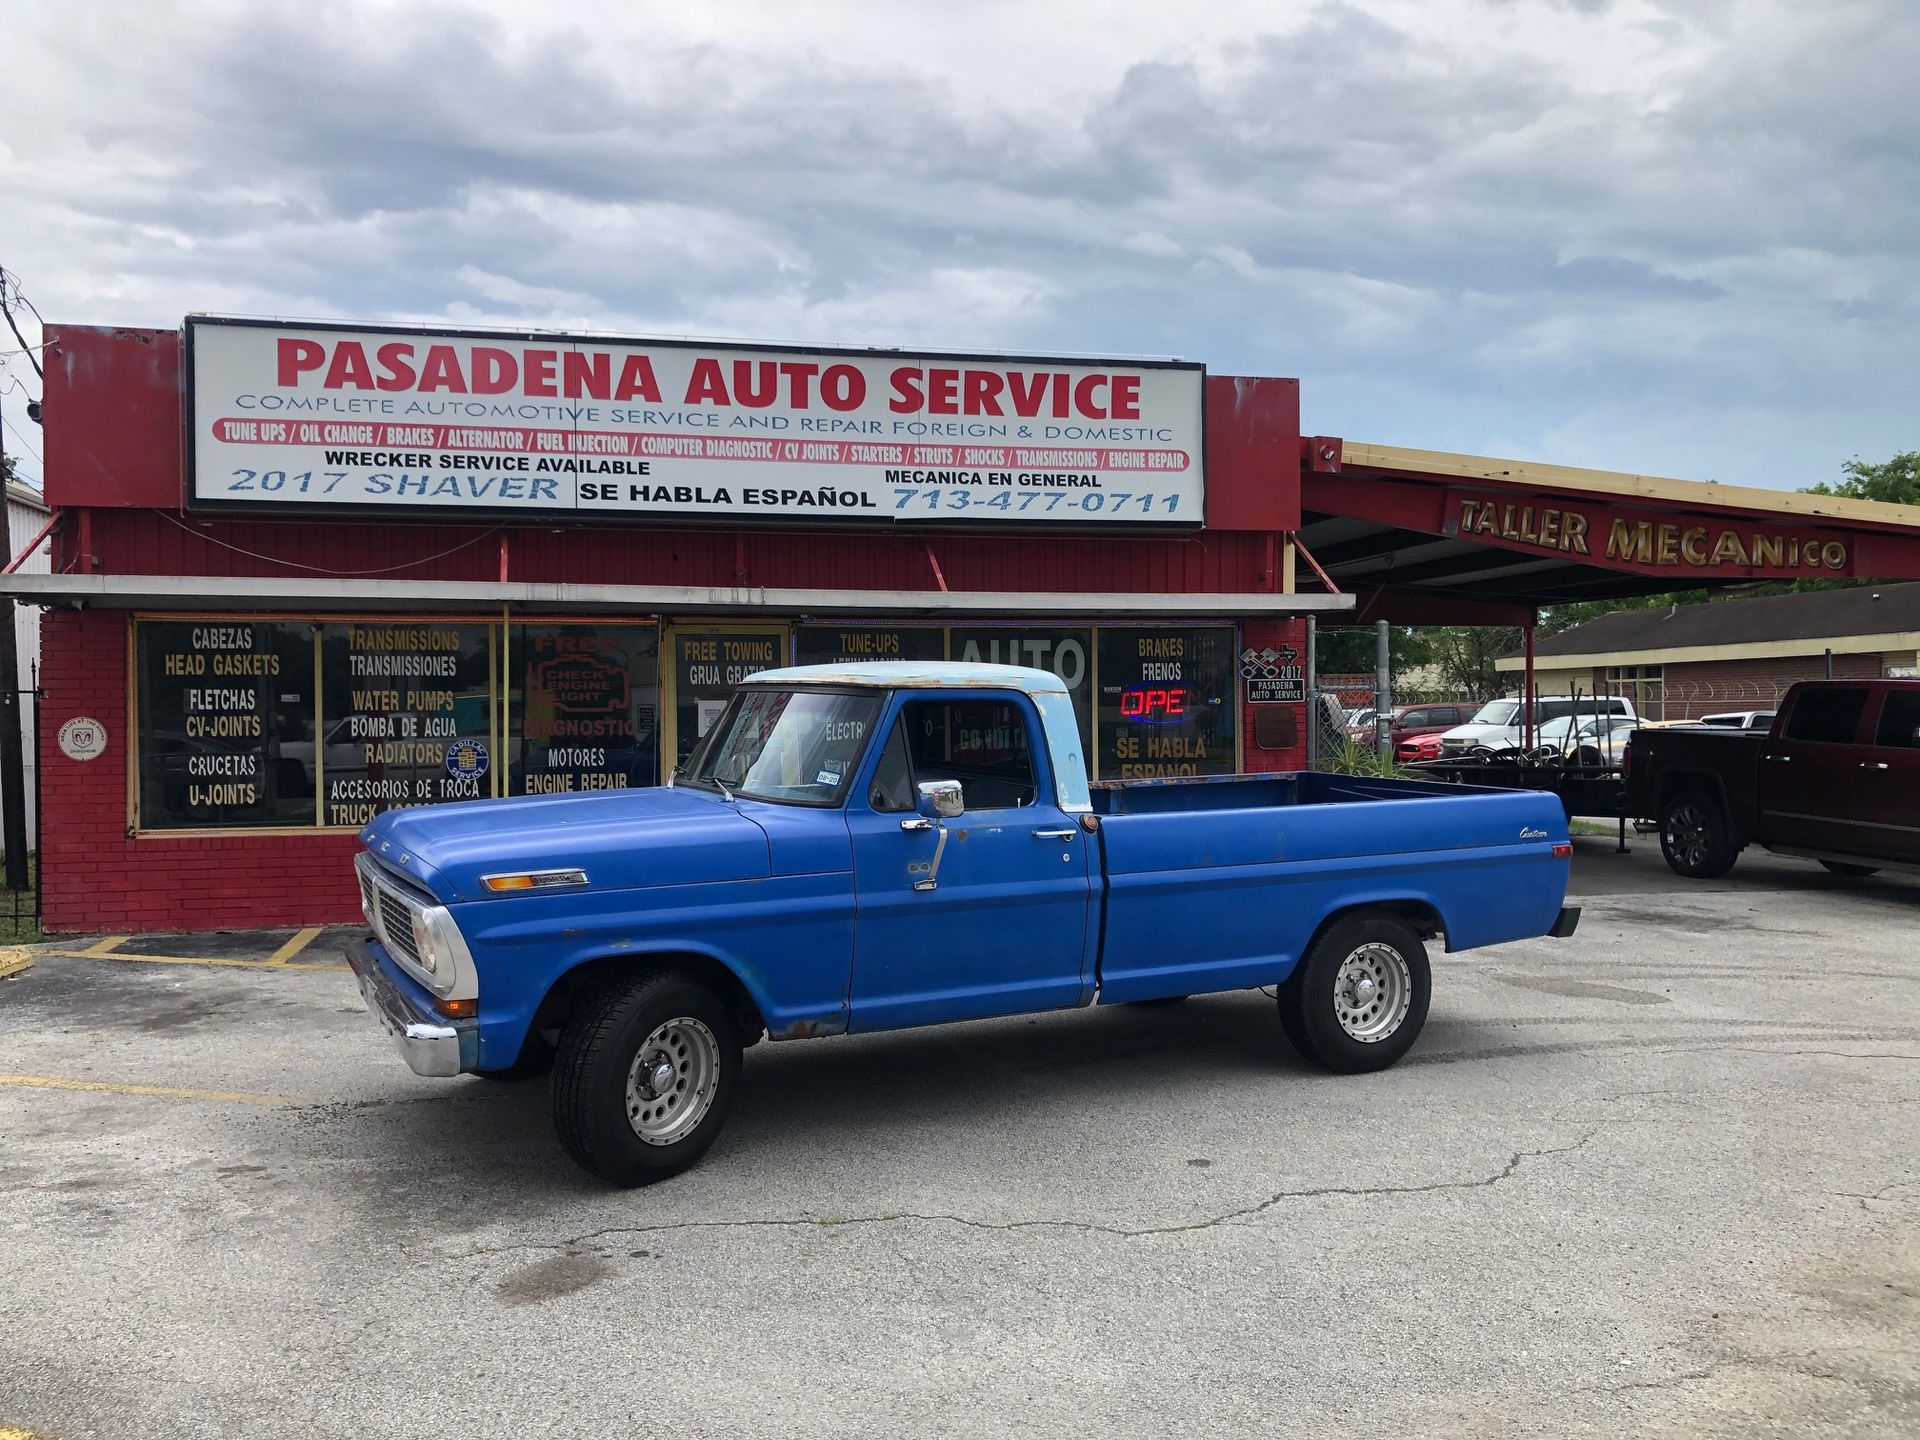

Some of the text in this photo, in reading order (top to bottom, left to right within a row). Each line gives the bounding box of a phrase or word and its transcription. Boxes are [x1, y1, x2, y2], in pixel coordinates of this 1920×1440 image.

[276, 338, 1140, 420] PASADENA AUTO SERVICE
[235, 394, 1173, 442] COMPLETE AUTOMOTIVE SERVICE AND REPAIR FOREIGN & DOMESTIC
[223, 421, 257, 441] TUNE
[260, 422, 286, 442] UPS
[300, 424, 321, 443] OIL
[324, 425, 373, 445] CHANGE
[387, 426, 434, 446] BRAKES
[447, 428, 523, 450] ALTERNATOR
[537, 432, 564, 451] FUEL
[568, 433, 628, 454] INJECTION
[641, 436, 702, 456] COMPUTER
[707, 439, 773, 460] DIAGNOSTIC
[784, 442, 799, 460] CV
[802, 443, 840, 461] JOINTS
[851, 445, 902, 464] STARTERS
[914, 446, 953, 465] STRUTS
[964, 448, 1004, 466] SHOCKS
[1016, 449, 1097, 468] TRANSMISSIONS
[1109, 451, 1145, 468] ENGINE
[1148, 452, 1185, 469] REPAIR
[325, 450, 650, 475] WRECKER SERVICE AVAILABLE
[227, 468, 560, 500] 2017 SHAVER
[885, 470, 1102, 487] MECANICA EN GENERAL
[579, 483, 876, 508] SE HABLA ESPAÑOL
[893, 488, 1180, 513] 713-477-0711
[1459, 499, 1591, 554] TALLER
[192, 628, 252, 649] CABEZAS
[348, 630, 460, 650] TRANSMISSIONS
[534, 636, 620, 653] FREE
[839, 633, 900, 653] TUNE-UPS
[1138, 638, 1184, 657] BRAKES
[684, 641, 773, 661] FREE TOWING
[165, 654, 280, 675] HEAD GASKETS
[350, 655, 457, 677] TRANSMISSIONES
[547, 670, 606, 680] CHECK
[689, 665, 765, 685] GRUA GRA
[1142, 662, 1182, 681] FRENOS
[1280, 665, 1302, 679] 2017
[547, 681, 612, 690] ENGINE
[1251, 690, 1301, 699] AUTO SERVICE
[1257, 681, 1294, 690] PASADENA
[190, 689, 255, 710] FLETCHAS
[352, 690, 454, 711] WATER PUMPS
[552, 692, 602, 701] LIGHT
[186, 715, 261, 737] CV-JOINTS
[351, 717, 457, 738] BOMBA DE AGUA
[523, 719, 637, 736] DIAGNOSTIC
[365, 743, 443, 764] RADIATORS
[450, 740, 486, 755] CADILLAC
[548, 747, 605, 768] MOTORES
[1116, 737, 1207, 758] SE HABLA
[189, 755, 256, 776] CRUCETAS
[450, 767, 485, 779] SERVICE
[331, 778, 480, 800] ACCESORIOS DE TROCA
[525, 772, 628, 794] ENGINE REPAIR
[189, 783, 255, 805] U-JOINTS
[330, 804, 377, 825] TRUCK
